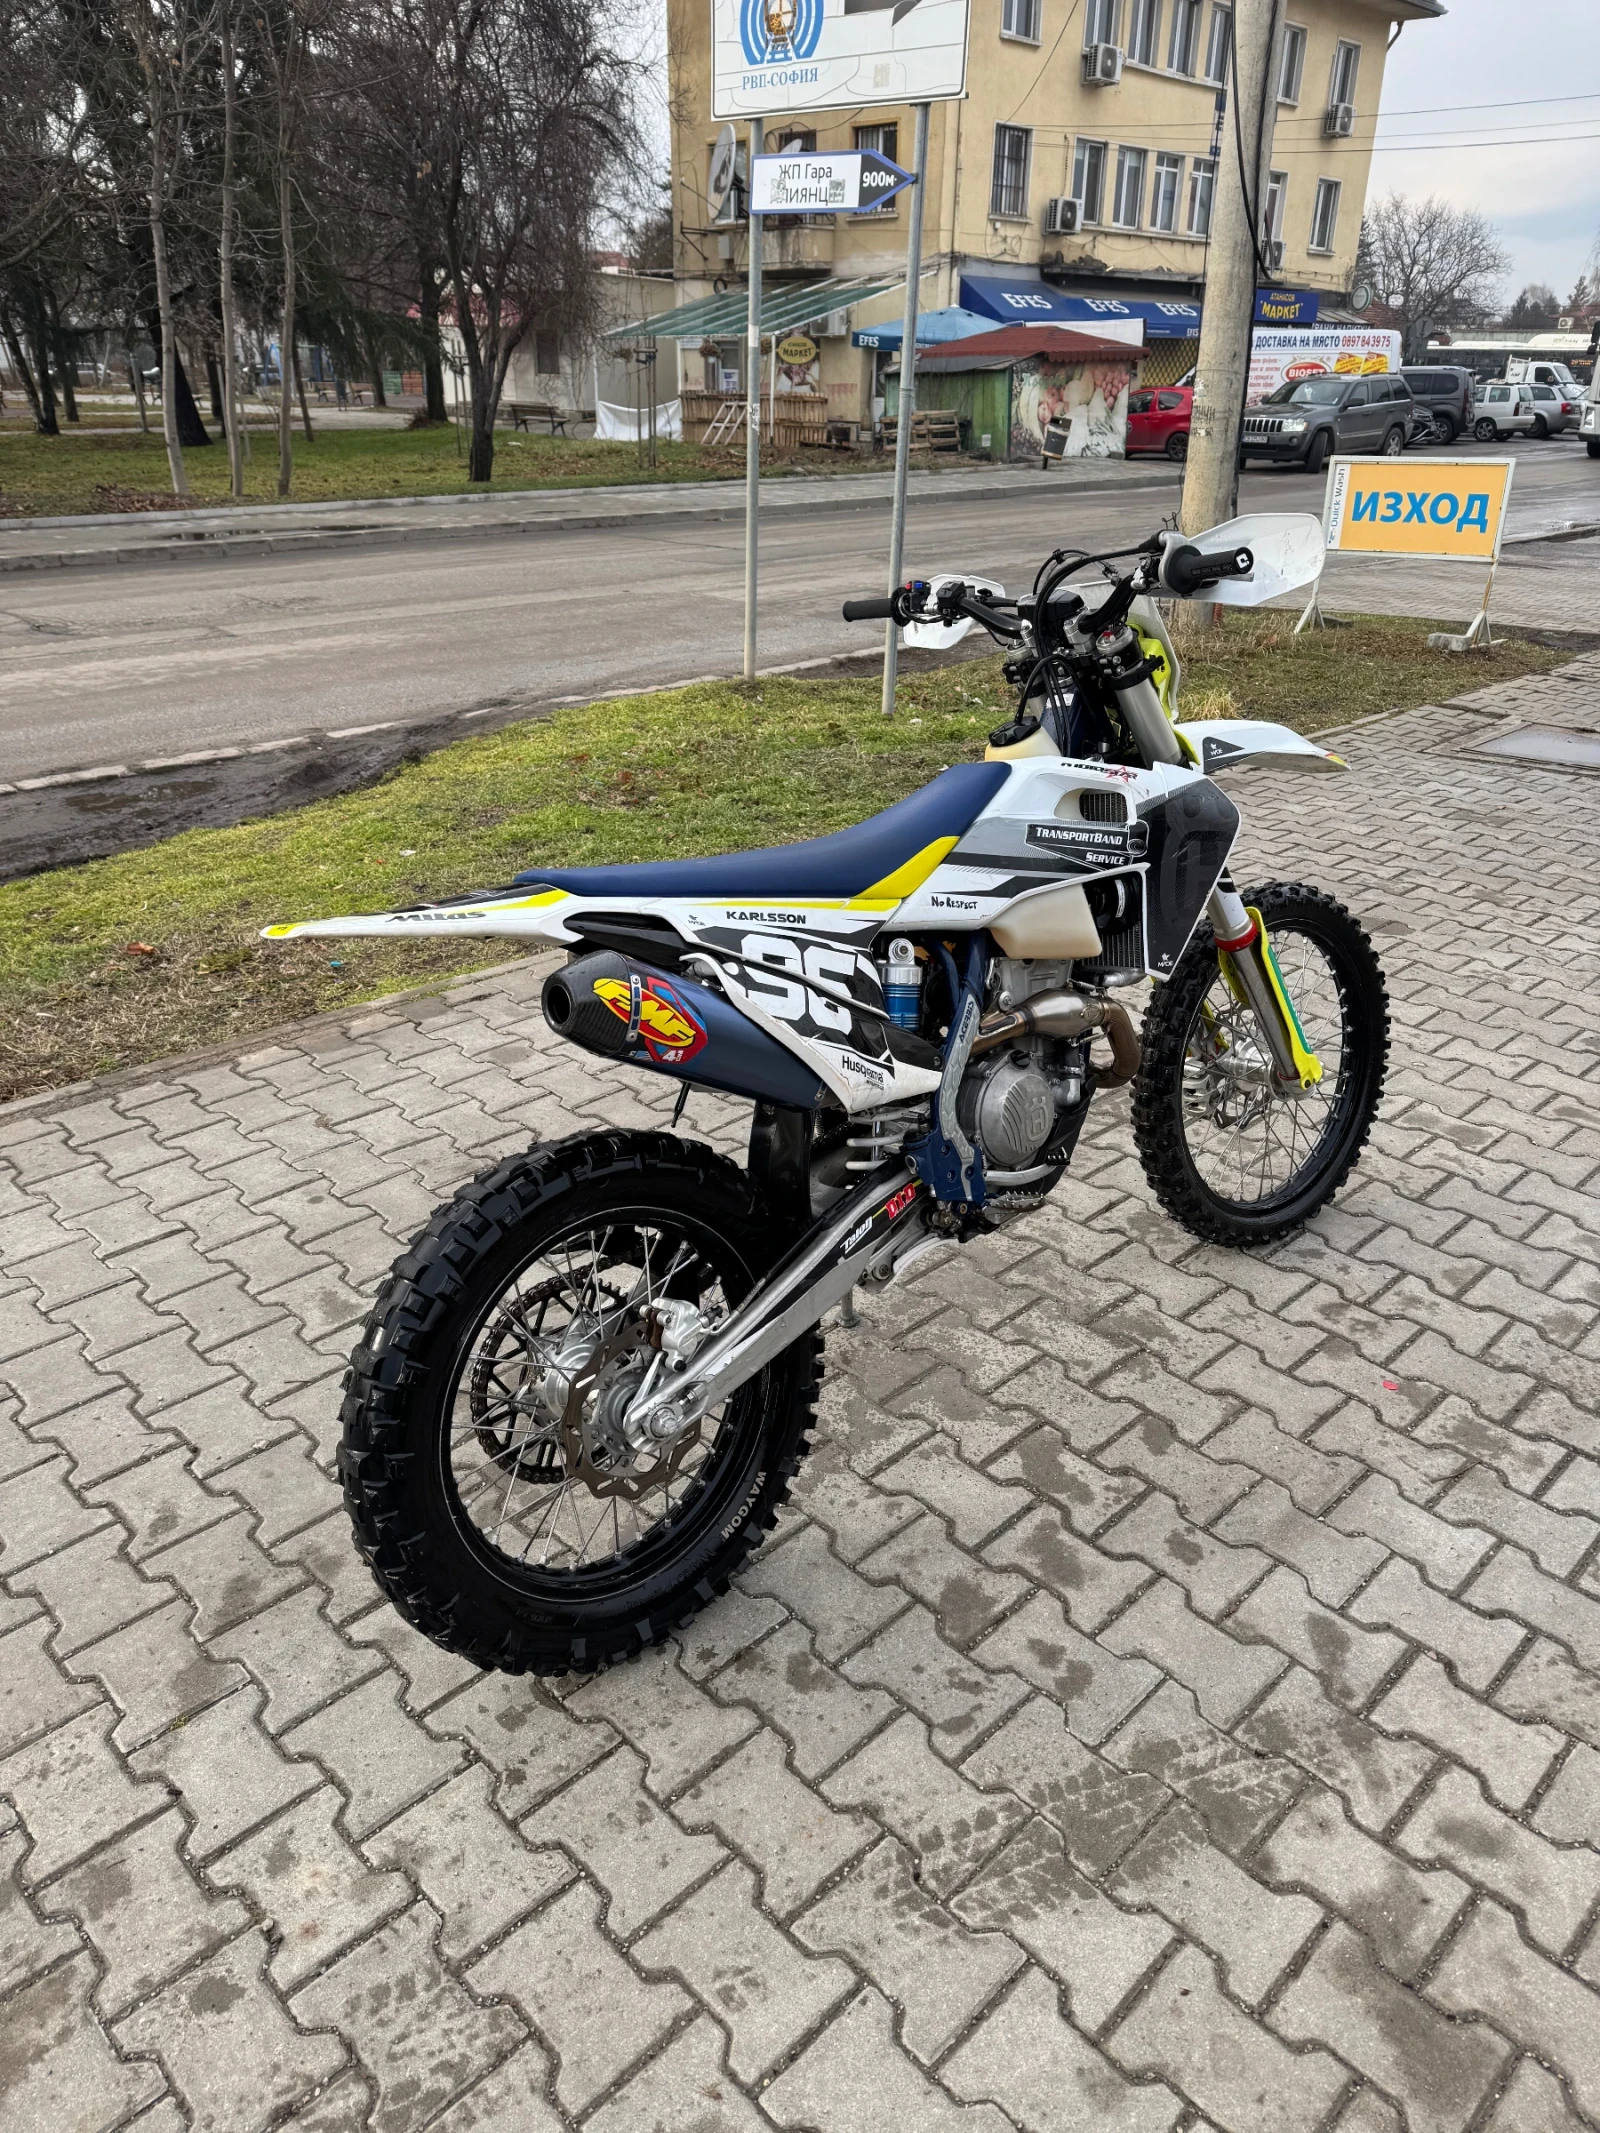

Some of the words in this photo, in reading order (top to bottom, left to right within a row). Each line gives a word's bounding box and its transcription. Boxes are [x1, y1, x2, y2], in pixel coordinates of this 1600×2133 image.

[779, 163, 801, 180] ЖП
[804, 163, 833, 184] Гара
[1001, 292, 1052, 309] EFES
[1083, 298, 1130, 314] EFES
[1155, 302, 1198, 317] EFES
[858, 334, 880, 348] EFES
[1255, 335, 1298, 350] ДОСТАВКА
[1299, 335, 1310, 348] НА
[1311, 336, 1340, 348] МЯСТО
[1334, 468, 1346, 497] Wash
[1351, 491, 1490, 534] ИЗХОД
[726, 911, 806, 924] KARLSSON
[593, 980, 696, 1040] FMF
[840, 1216, 873, 1254] Talon
